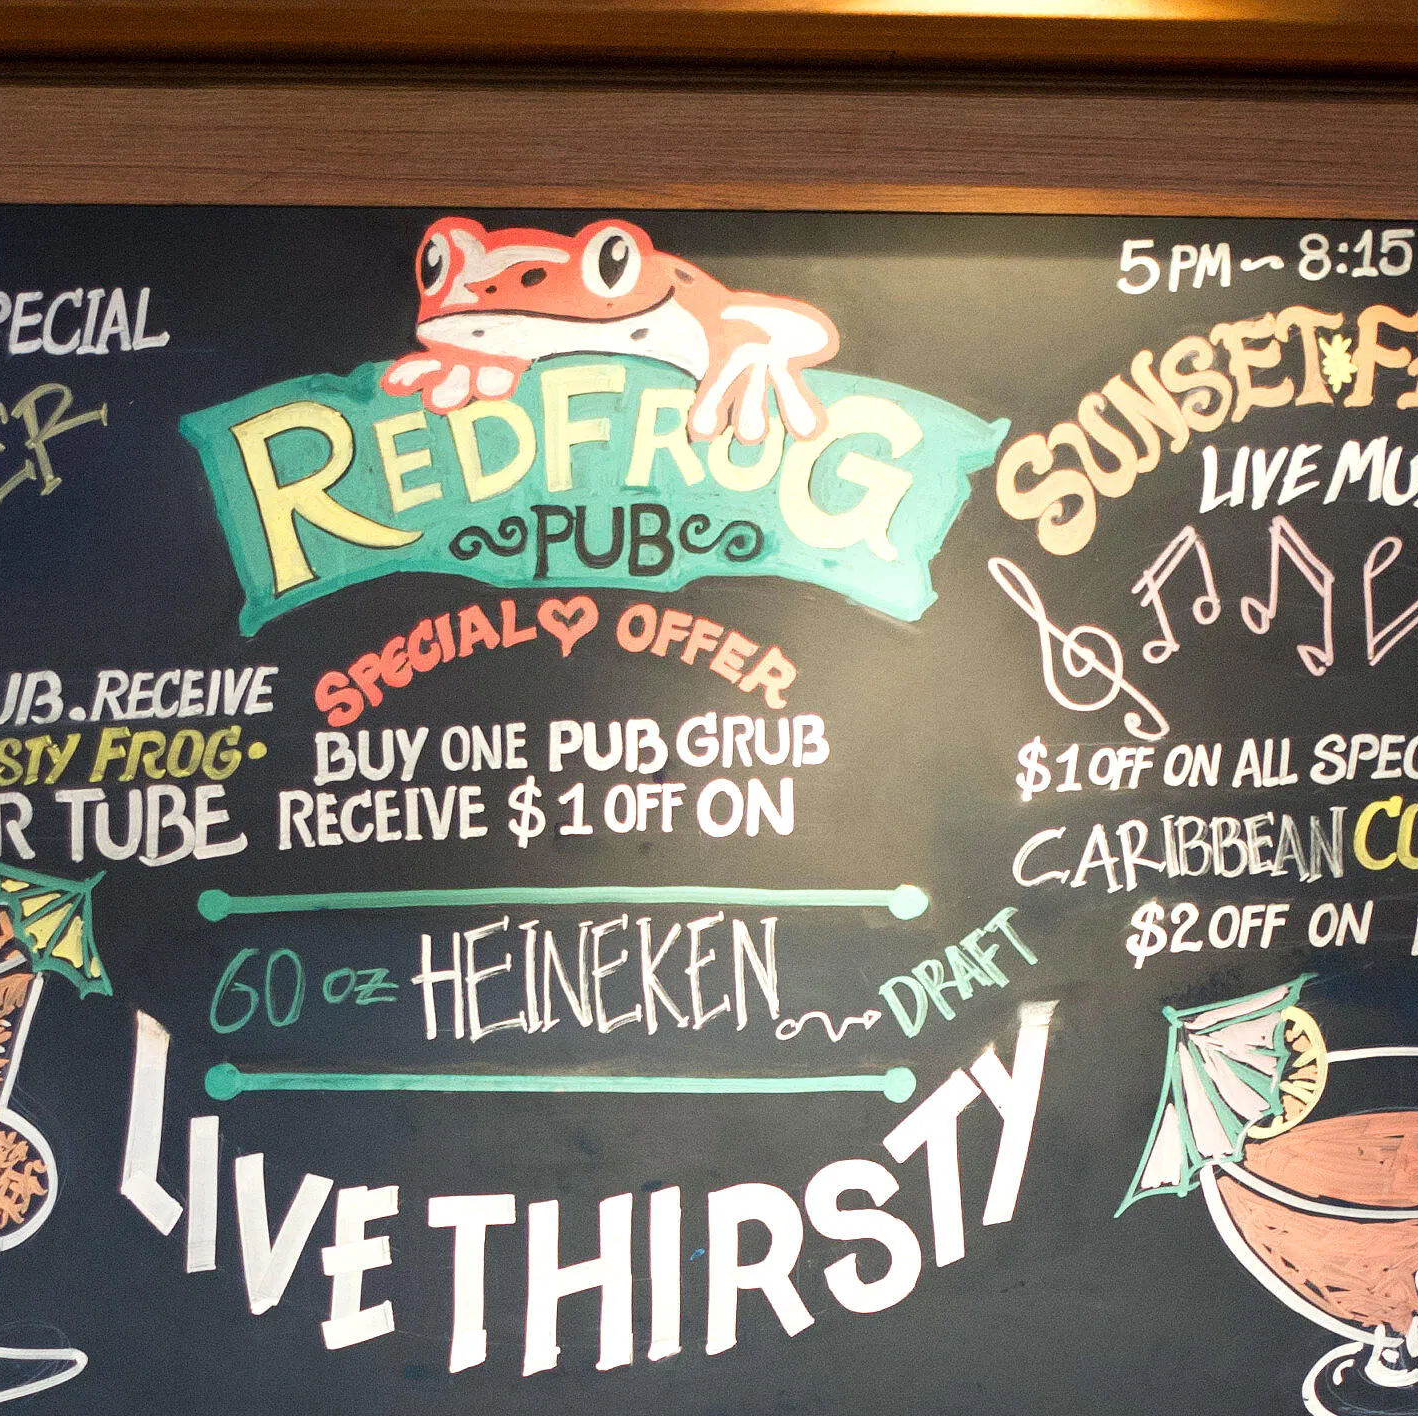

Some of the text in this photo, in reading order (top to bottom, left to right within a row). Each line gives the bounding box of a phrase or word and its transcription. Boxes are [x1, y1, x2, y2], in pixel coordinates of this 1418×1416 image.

[1298, 229, 1415, 280] 8:15
[996, 305, 1344, 556] SUNSET
[1199, 441, 1324, 514] LIVE
[531, 503, 676, 578] PUB
[314, 599, 797, 727] SPECIAL OFFER
[89, 725, 243, 784] FROG
[314, 714, 829, 786] BUY ONE PUB GRUB
[1164, 742, 1222, 788] ON
[1231, 736, 1298, 788] ALL
[55, 785, 249, 867] TUBE
[278, 786, 489, 851] RECEIVE
[603, 785, 684, 834] OFF
[697, 778, 795, 839] ON
[1012, 806, 1347, 895] CARIBBEAN
[1307, 899, 1374, 947] ON
[209, 948, 307, 1036] 60
[412, 913, 782, 1043] HEINEKEN
[877, 906, 1040, 1039] DRAFT
[121, 1000, 1060, 1376] LIVE THIRSTY
